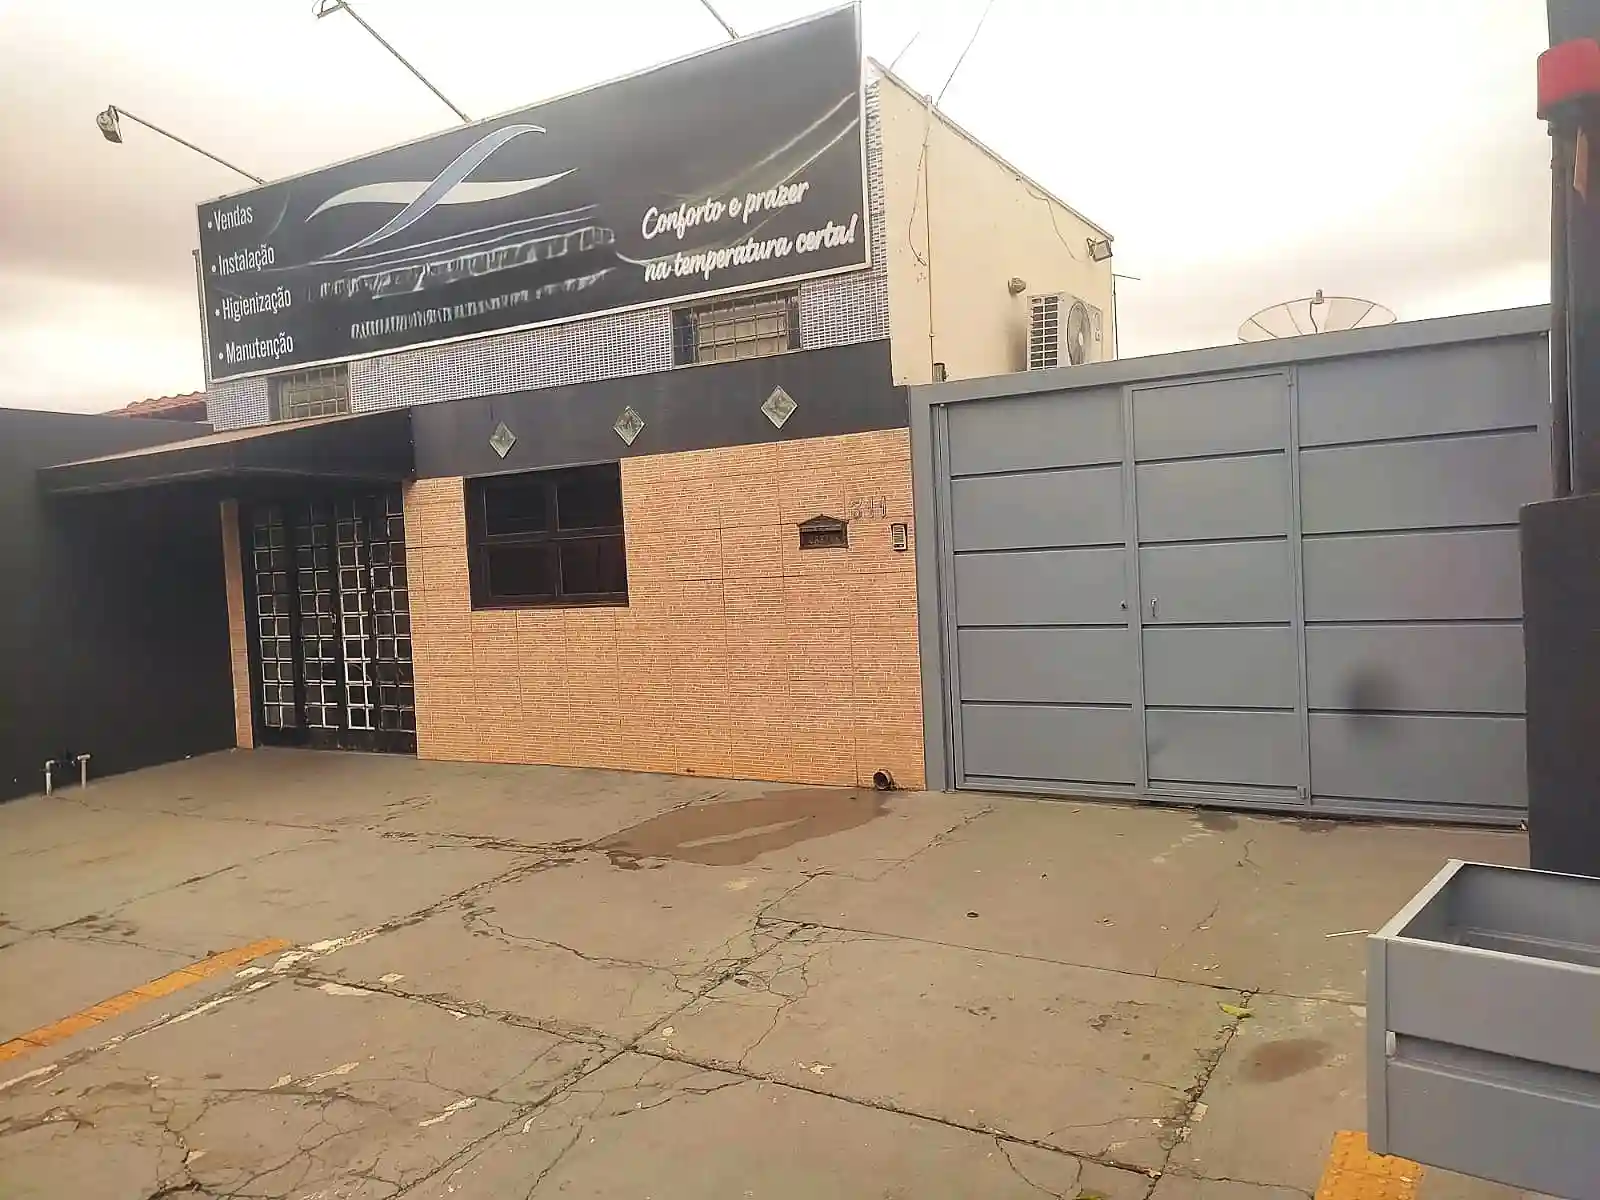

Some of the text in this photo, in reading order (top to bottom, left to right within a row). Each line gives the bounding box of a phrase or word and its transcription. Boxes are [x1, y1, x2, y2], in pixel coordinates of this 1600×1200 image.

[213, 204, 253, 232] Vendas
[642, 181, 810, 239] Conforto e prazer
[218, 243, 275, 276] Instalação
[644, 259, 672, 283] na
[673, 236, 793, 280] temperatura
[795, 213, 858, 253] certa!
[222, 286, 292, 322] Higienização
[225, 331, 294, 364] Manutenção
